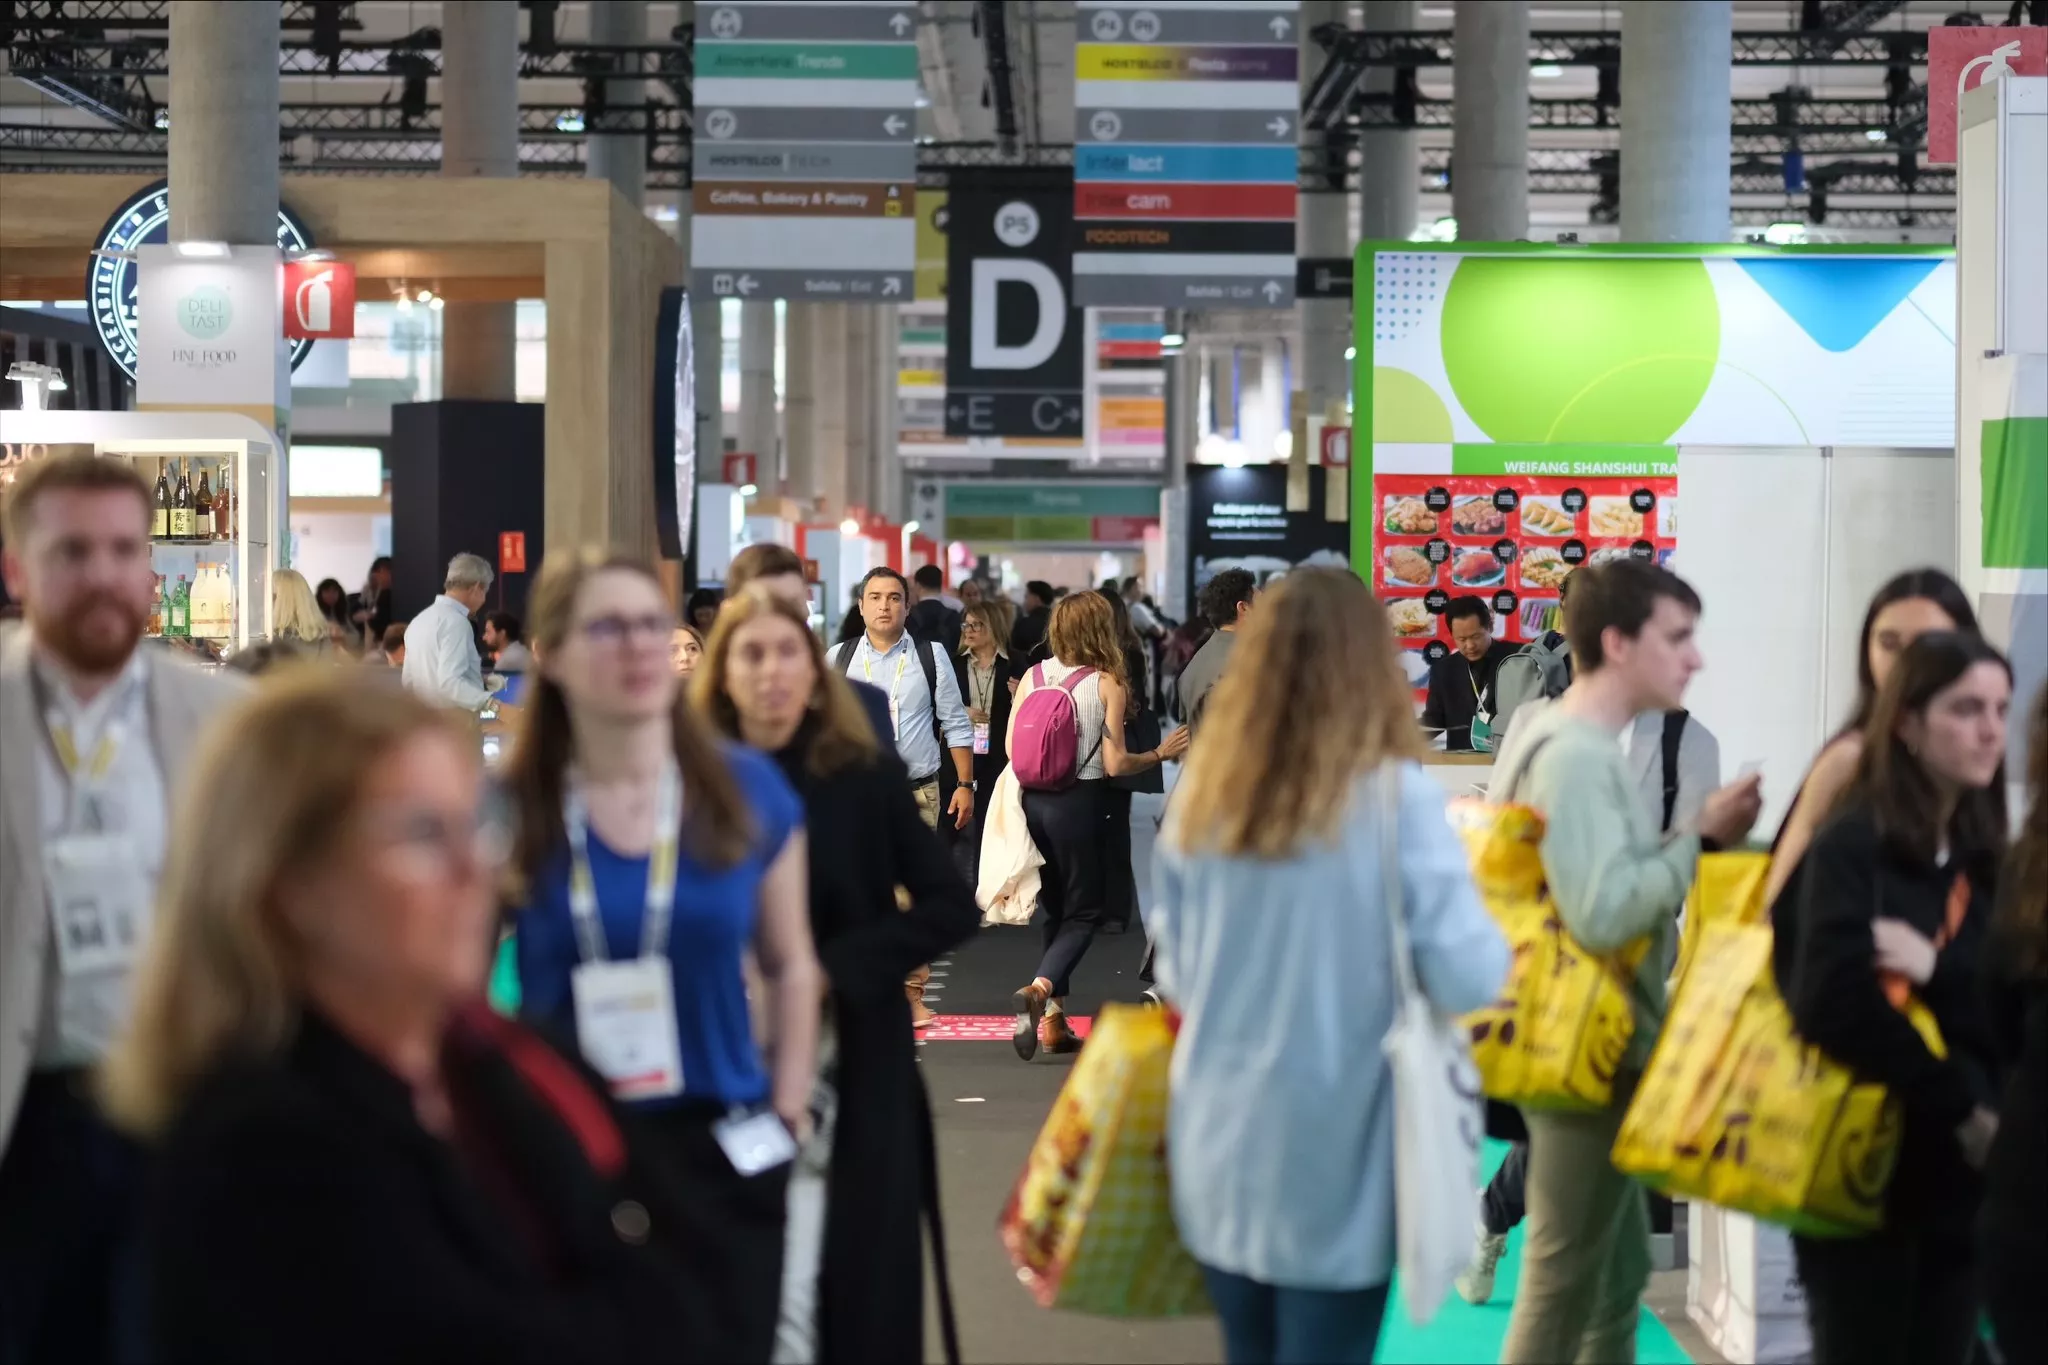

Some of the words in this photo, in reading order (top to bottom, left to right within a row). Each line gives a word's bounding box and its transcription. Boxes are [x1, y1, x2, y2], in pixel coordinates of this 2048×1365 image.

[1003, 214, 1030, 235] P5
[188, 299, 222, 313] DELI
[971, 258, 1066, 370] D
[190, 315, 224, 329] TAST
[203, 349, 237, 362] FOOD
[968, 395, 994, 430] E
[1031, 396, 1063, 431] C
[1504, 461, 1569, 474] WEIFANG
[1573, 462, 1647, 474] SHANSHUI
